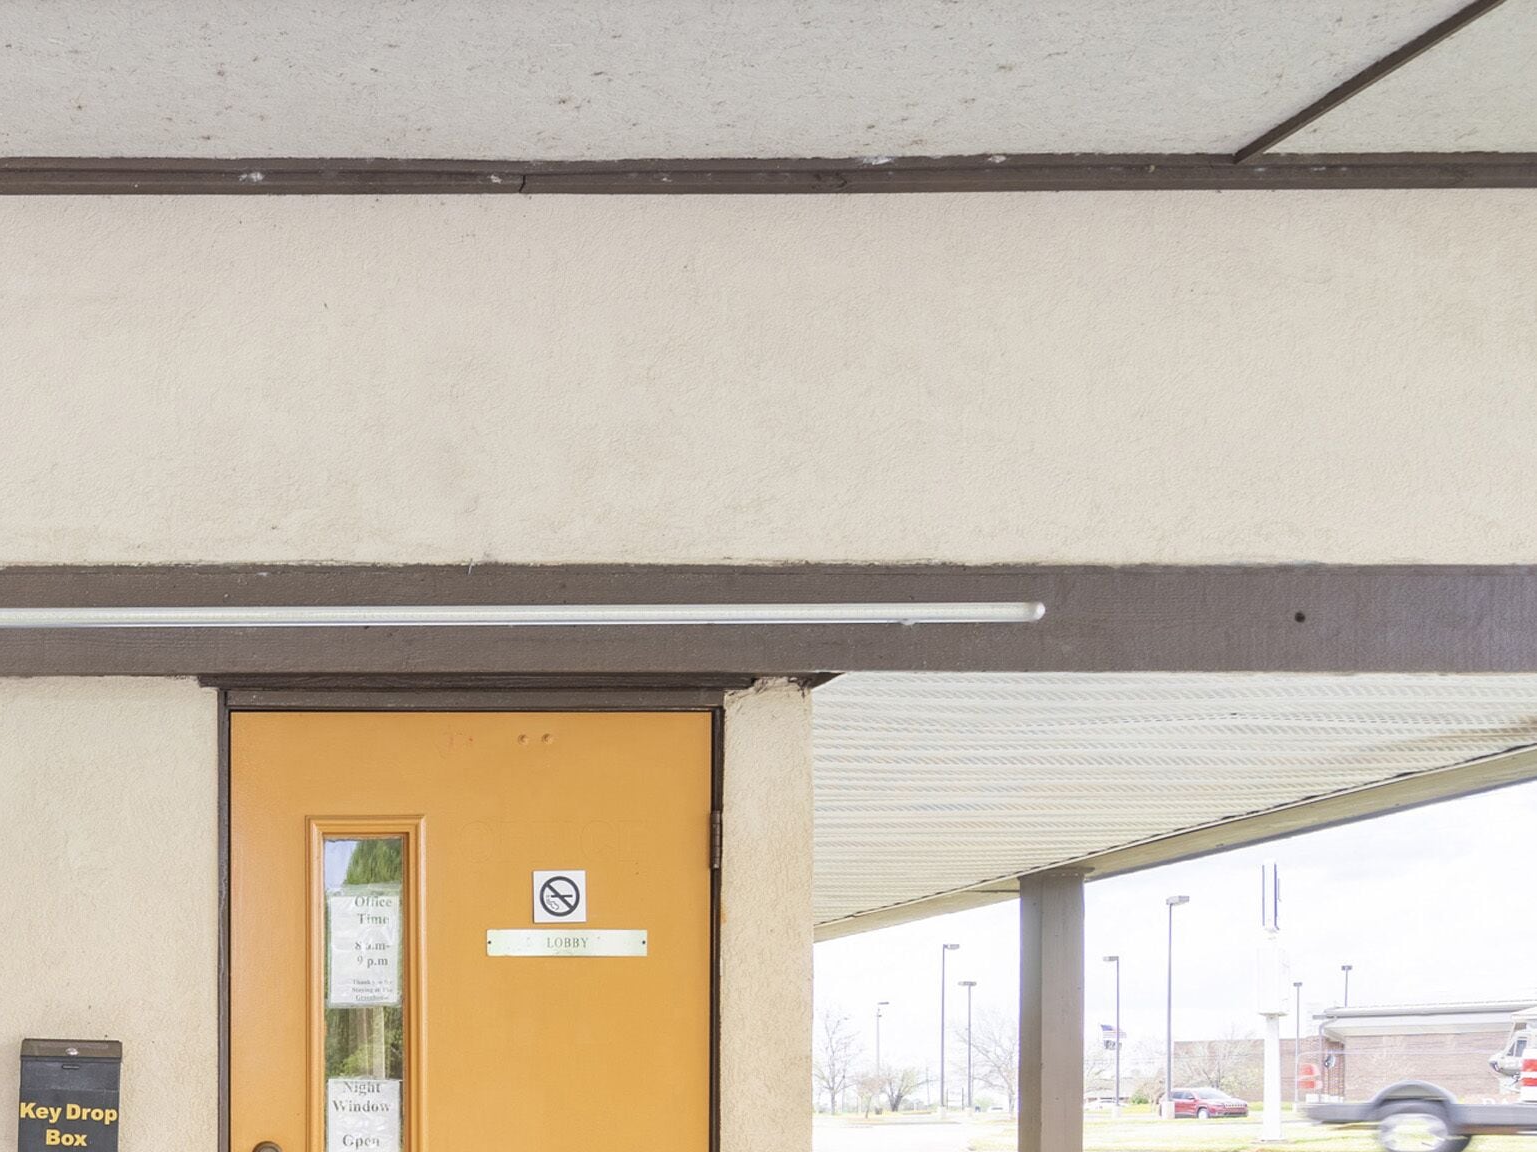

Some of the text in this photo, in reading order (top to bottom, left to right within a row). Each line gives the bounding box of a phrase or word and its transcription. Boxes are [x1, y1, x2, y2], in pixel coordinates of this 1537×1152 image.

[355, 895, 392, 907] Office
[357, 913, 390, 925] Time
[547, 937, 589, 949] LOBBY
[357, 955, 388, 969] 9 p.m
[344, 1081, 381, 1096] Night
[332, 1100, 391, 1112] Window
[19, 1102, 118, 1125] Key Drop
[46, 1129, 87, 1146] Box
[343, 1134, 381, 1149] Open
